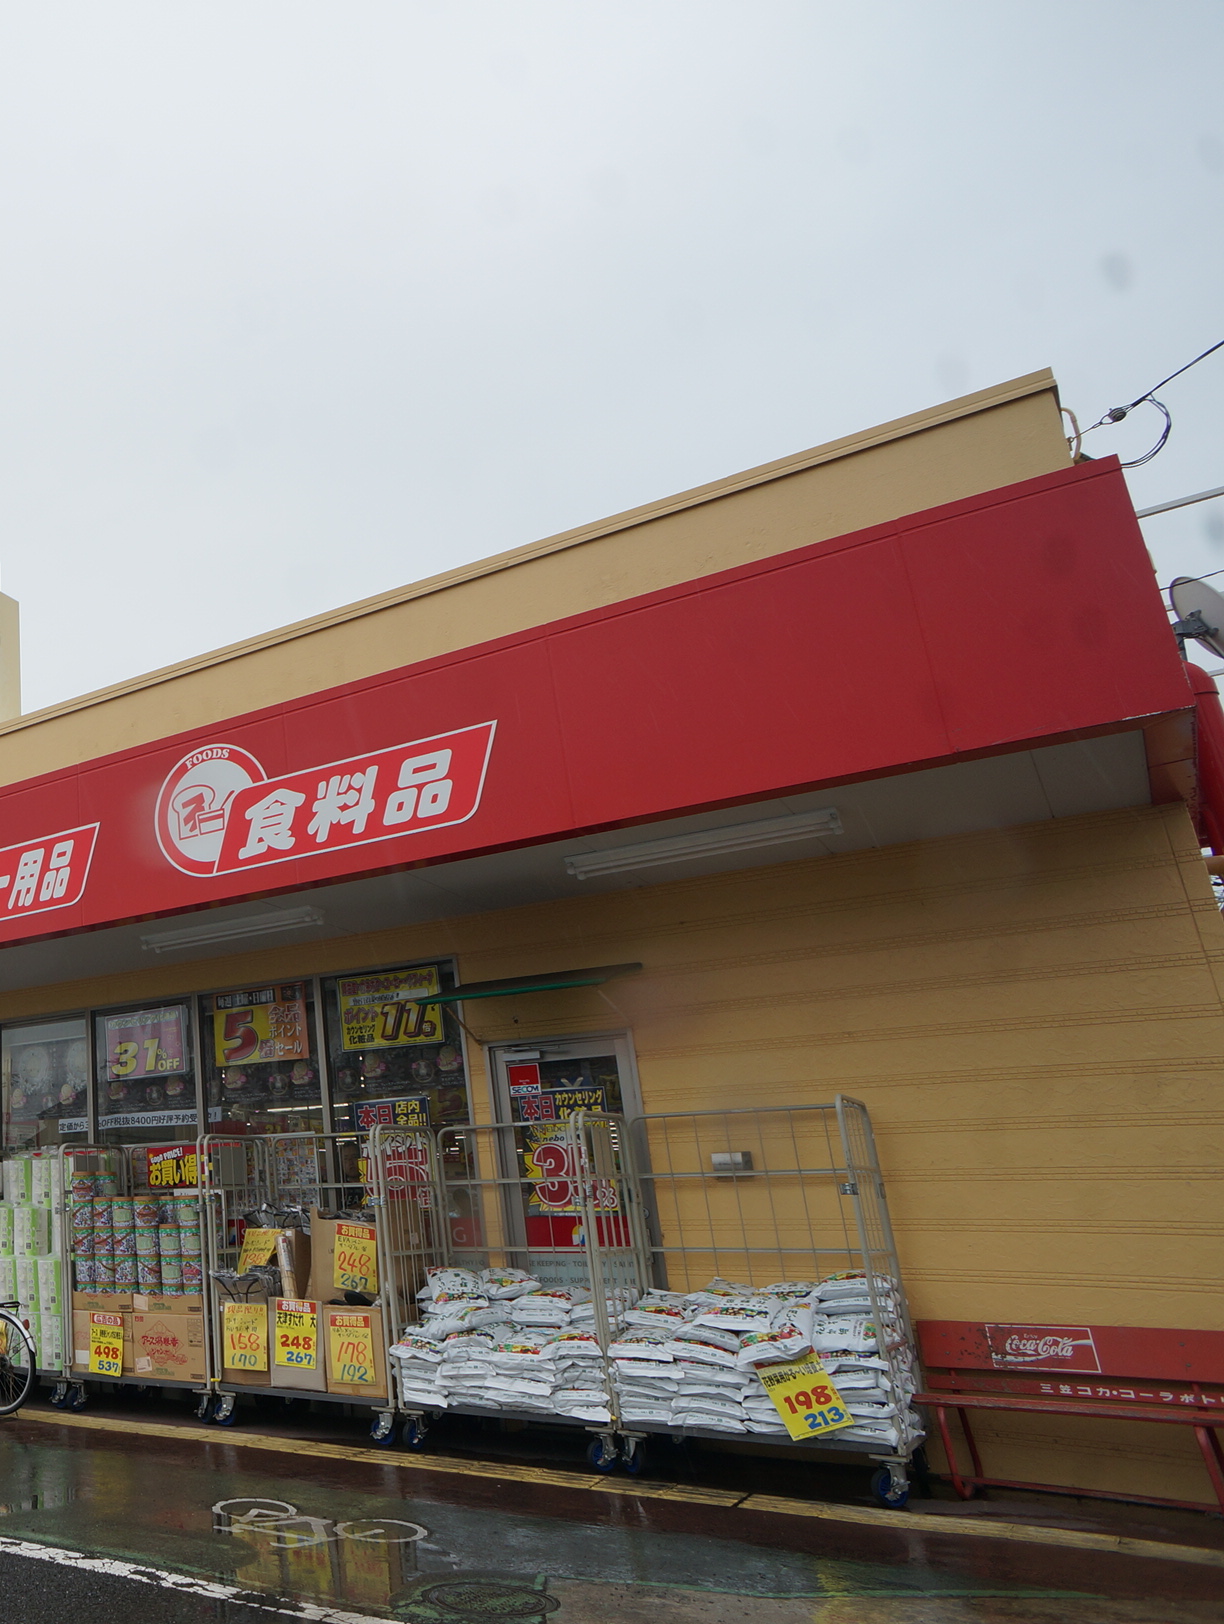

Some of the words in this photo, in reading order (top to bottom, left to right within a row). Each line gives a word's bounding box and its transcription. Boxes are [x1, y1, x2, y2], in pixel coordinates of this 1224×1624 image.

[185, 748, 230, 770] FOODS
[238, 749, 453, 860] 食料品
[344, 1007, 378, 1025] ポイント
[223, 1009, 259, 1063] 5
[269, 1024, 302, 1038] ポイント
[349, 1034, 375, 1045] 化粧品
[276, 1041, 303, 1056] セール
[158, 1058, 180, 1072] OFF
[512, 1085, 539, 1094] SECOM
[555, 1090, 603, 1106] カウンセリング
[395, 1101, 420, 1114] 店内
[521, 1096, 556, 1121] 本日
[358, 1104, 394, 1130] 本日
[341, 1225, 370, 1239] お買得品
[338, 1250, 371, 1276] 248
[341, 1273, 369, 1290] 267
[282, 1301, 311, 1313] お買得品
[336, 1315, 365, 1327] お買得品
[230, 1332, 260, 1352] 158
[280, 1334, 313, 1350] 248
[94, 1345, 120, 1360] 498
[231, 1353, 258, 1367] 170
[286, 1351, 313, 1365] 267
[337, 1341, 367, 1365] 178
[98, 1360, 119, 1373] 537
[341, 1364, 369, 1382] 192
[783, 1385, 833, 1414] 198
[804, 1406, 845, 1430] 213
